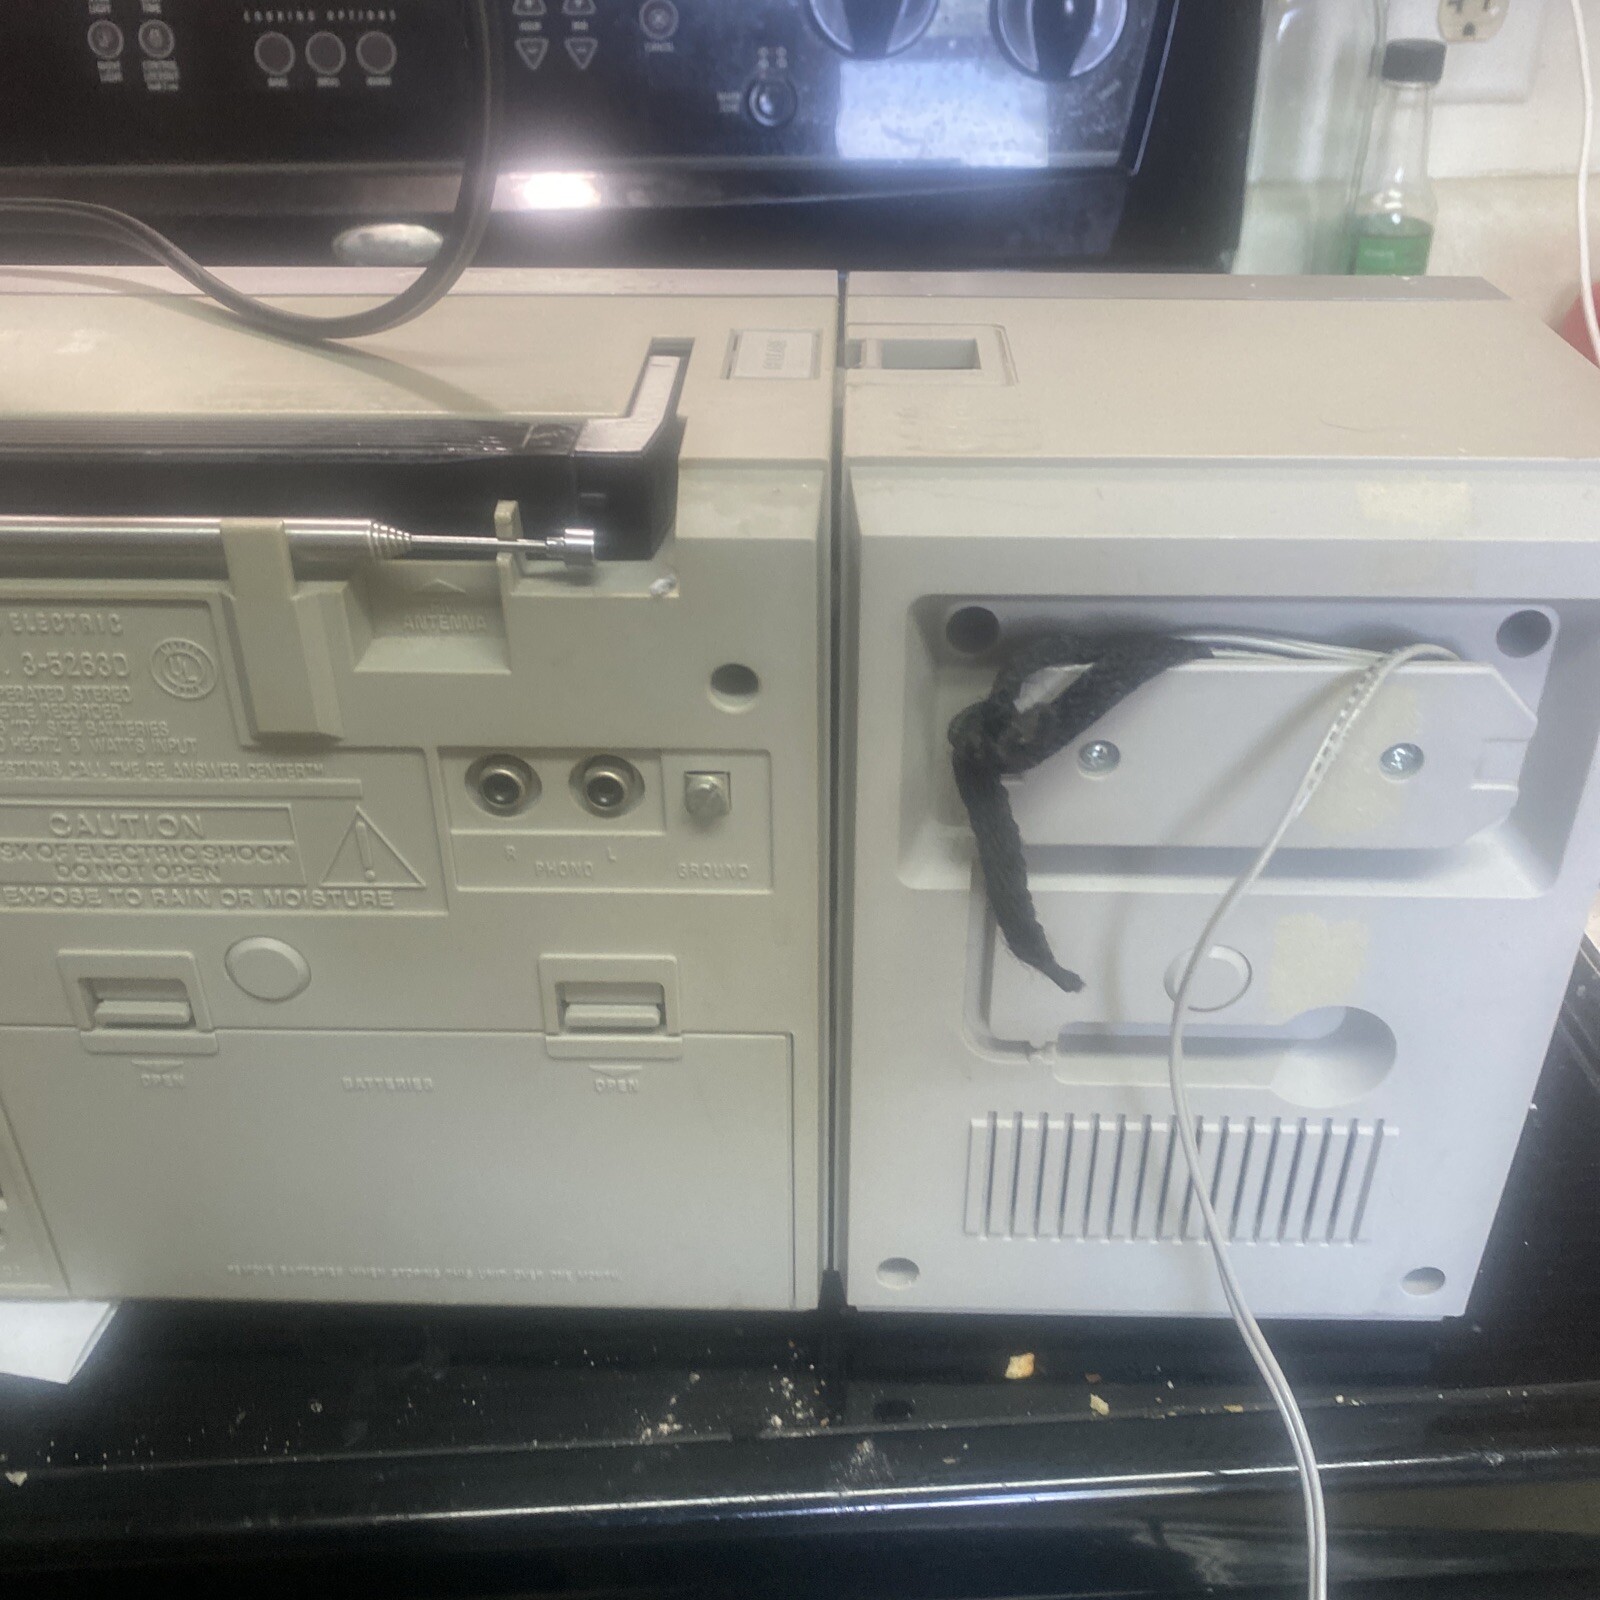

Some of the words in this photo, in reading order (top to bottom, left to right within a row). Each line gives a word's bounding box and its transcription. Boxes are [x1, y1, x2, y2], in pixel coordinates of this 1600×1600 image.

[8, 612, 123, 634] ELECTRIC
[404, 614, 488, 632] ANTENNA
[71, 685, 132, 703] STEREO
[39, 703, 122, 720] RECORDER
[47, 720, 82, 736] SIZE
[85, 720, 169, 737] BATTERIES
[10, 736, 61, 752] HERTZ
[88, 737, 146, 753] WATTS
[151, 738, 197, 754] INPUT
[68, 760, 108, 777] CALL
[110, 761, 142, 778] THE
[173, 762, 239, 779] ANSWER
[50, 812, 203, 838] CAUTION
[37, 843, 69, 863] OF
[74, 844, 198, 864] ELECTRIC
[201, 845, 291, 864] SHOCK
[55, 862, 91, 882] DO
[96, 863, 145, 882] NOT
[152, 864, 222, 883] OPEN
[535, 860, 594, 879] PHONO
[677, 862, 751, 880] GROUND
[2, 886, 101, 907] EXPOSE
[108, 887, 143, 907] TO
[151, 887, 212, 908] RAIN
[220, 888, 254, 908] OR
[263, 888, 395, 909] MOISTURE
[141, 1073, 186, 1088] OPEN
[342, 1076, 434, 1092] BATTERIES
[594, 1078, 639, 1094] OPEN
